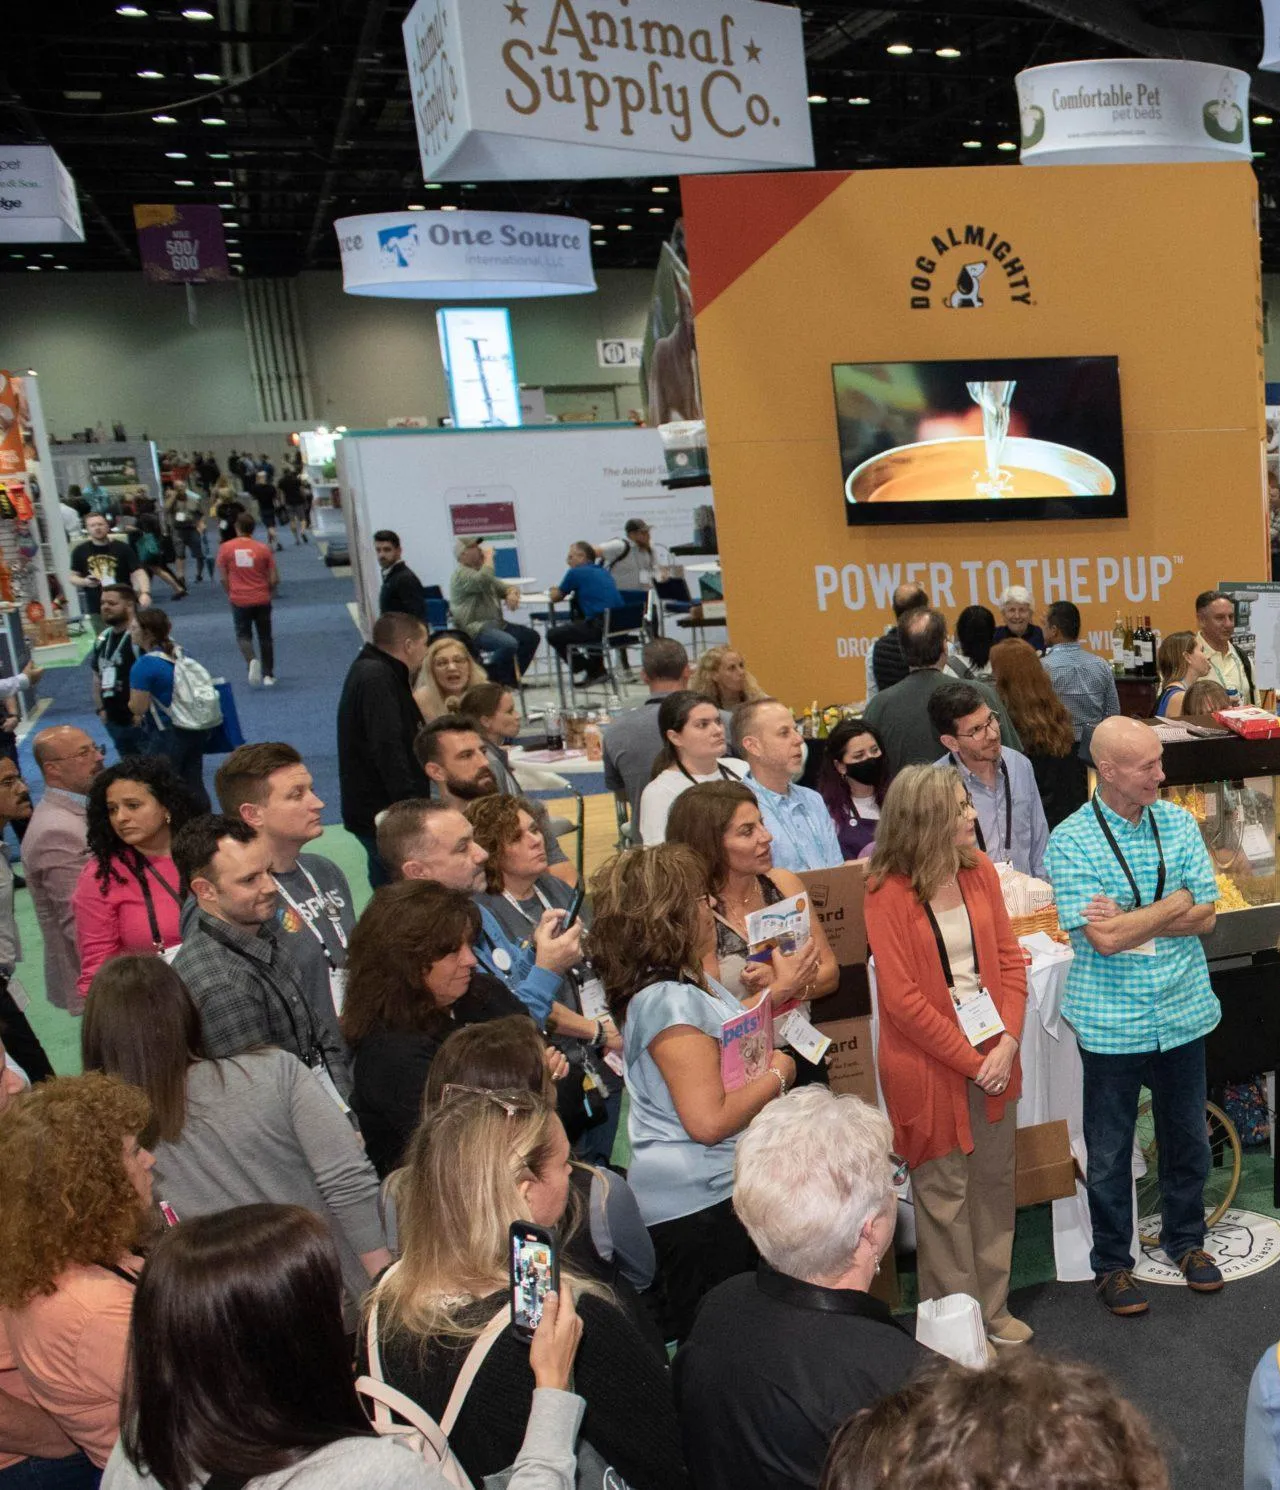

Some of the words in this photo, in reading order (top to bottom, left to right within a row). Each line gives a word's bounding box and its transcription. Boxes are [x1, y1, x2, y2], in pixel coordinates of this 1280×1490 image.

[538, 0, 735, 67] Animal
[502, 38, 692, 143] Supply
[701, 69, 781, 139] Co.
[1051, 84, 1133, 111] Comfortable
[1136, 83, 1161, 107] Pet
[1112, 108, 1131, 122] pet
[1134, 106, 1162, 120] beds
[165, 238, 200, 256] 500/
[428, 224, 494, 246] One
[500, 224, 581, 250] Source
[171, 255, 200, 271] 600
[930, 224, 1032, 306] ALMIGHTY
[911, 255, 937, 309] DOG
[603, 468, 620, 476] The
[622, 466, 656, 476] Animal
[621, 479, 653, 488] Mobile
[960, 560, 1010, 607] TO
[1016, 558, 1091, 606] THE
[1224, 1237, 1274, 1274] ACCREDITED
